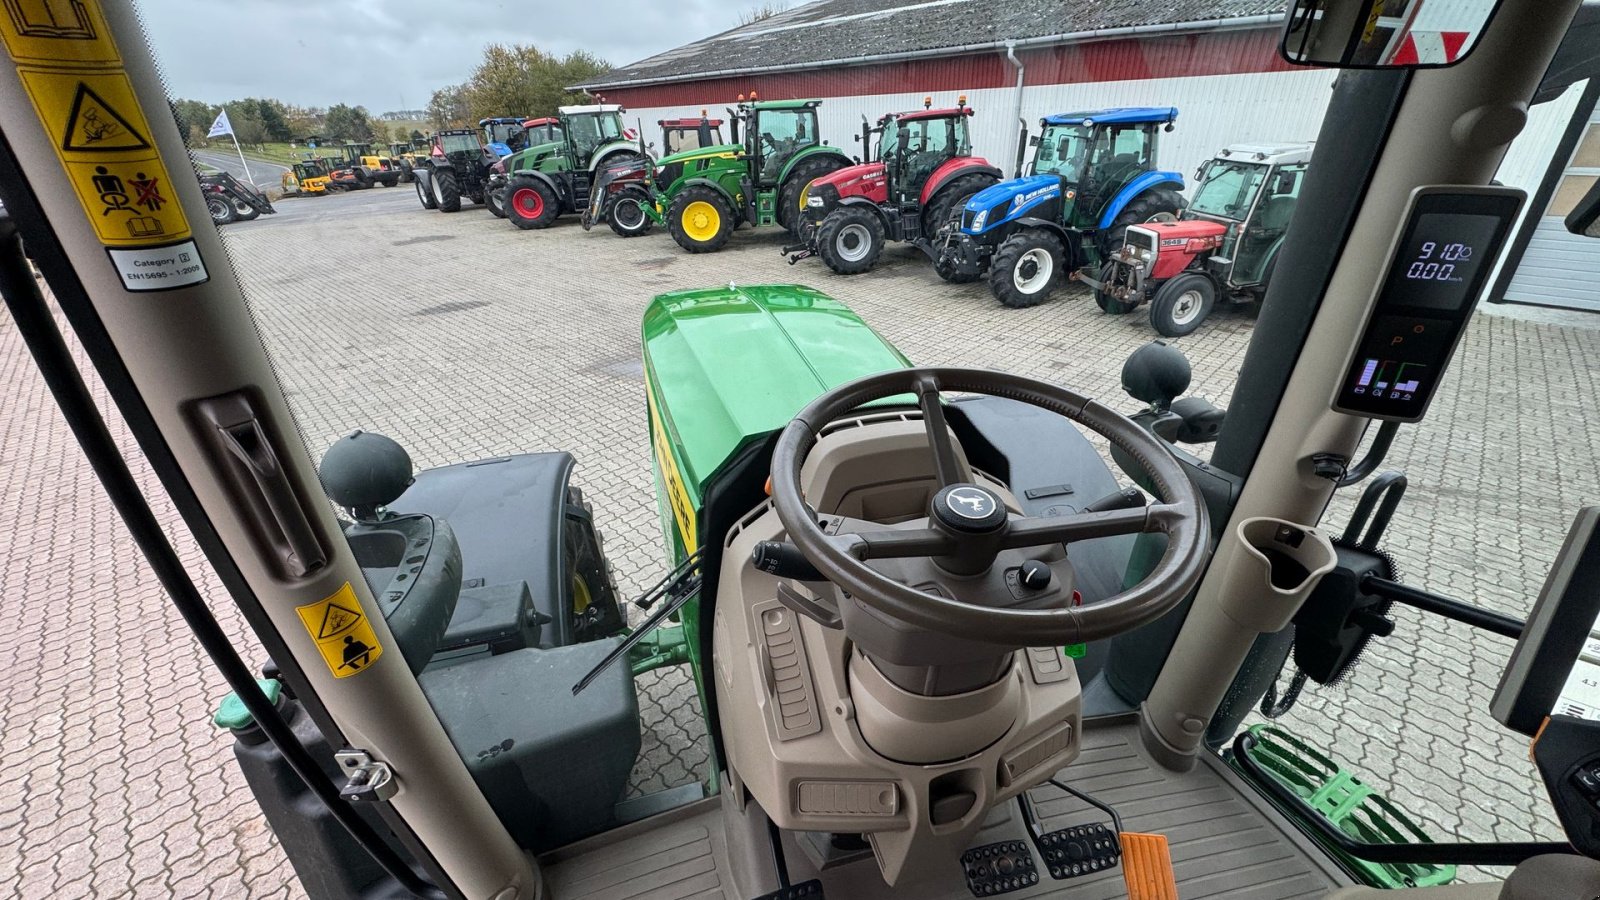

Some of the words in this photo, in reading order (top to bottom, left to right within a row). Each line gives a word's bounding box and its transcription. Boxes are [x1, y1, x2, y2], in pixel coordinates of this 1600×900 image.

[1025, 190, 1038, 200] NEW
[1037, 183, 1060, 195] HOLLAND
[134, 258, 175, 268] Category
[127, 272, 168, 280] EN15695
[176, 264, 200, 275] 1:2009
[1406, 262, 1455, 280] 0.00
[1391, 336, 1404, 346] P
[1582, 679, 1598, 688] 4.3
